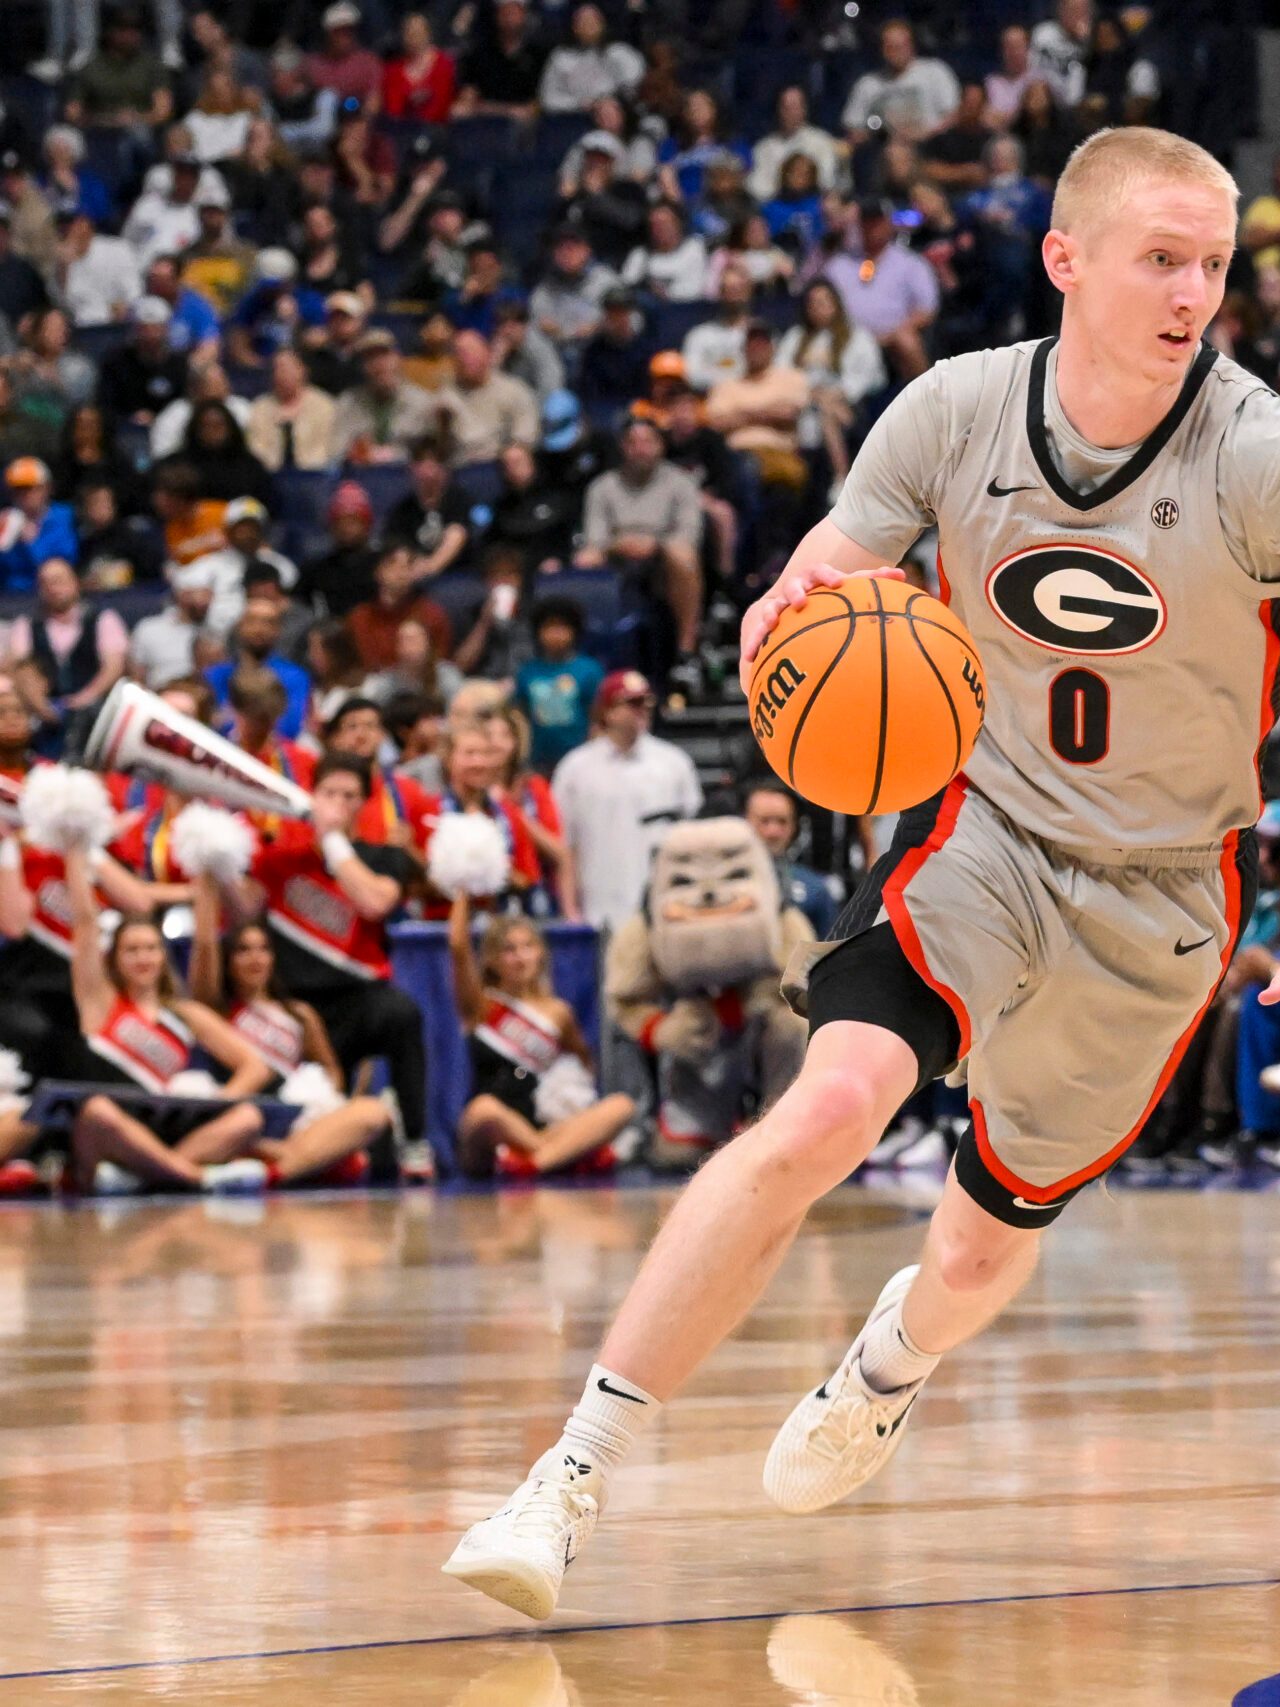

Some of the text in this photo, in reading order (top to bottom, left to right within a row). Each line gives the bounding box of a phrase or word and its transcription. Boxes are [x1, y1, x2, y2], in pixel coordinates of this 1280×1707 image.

[1154, 501, 1177, 526] SEC
[992, 548, 1160, 652] G
[1049, 666, 1111, 766] 0
